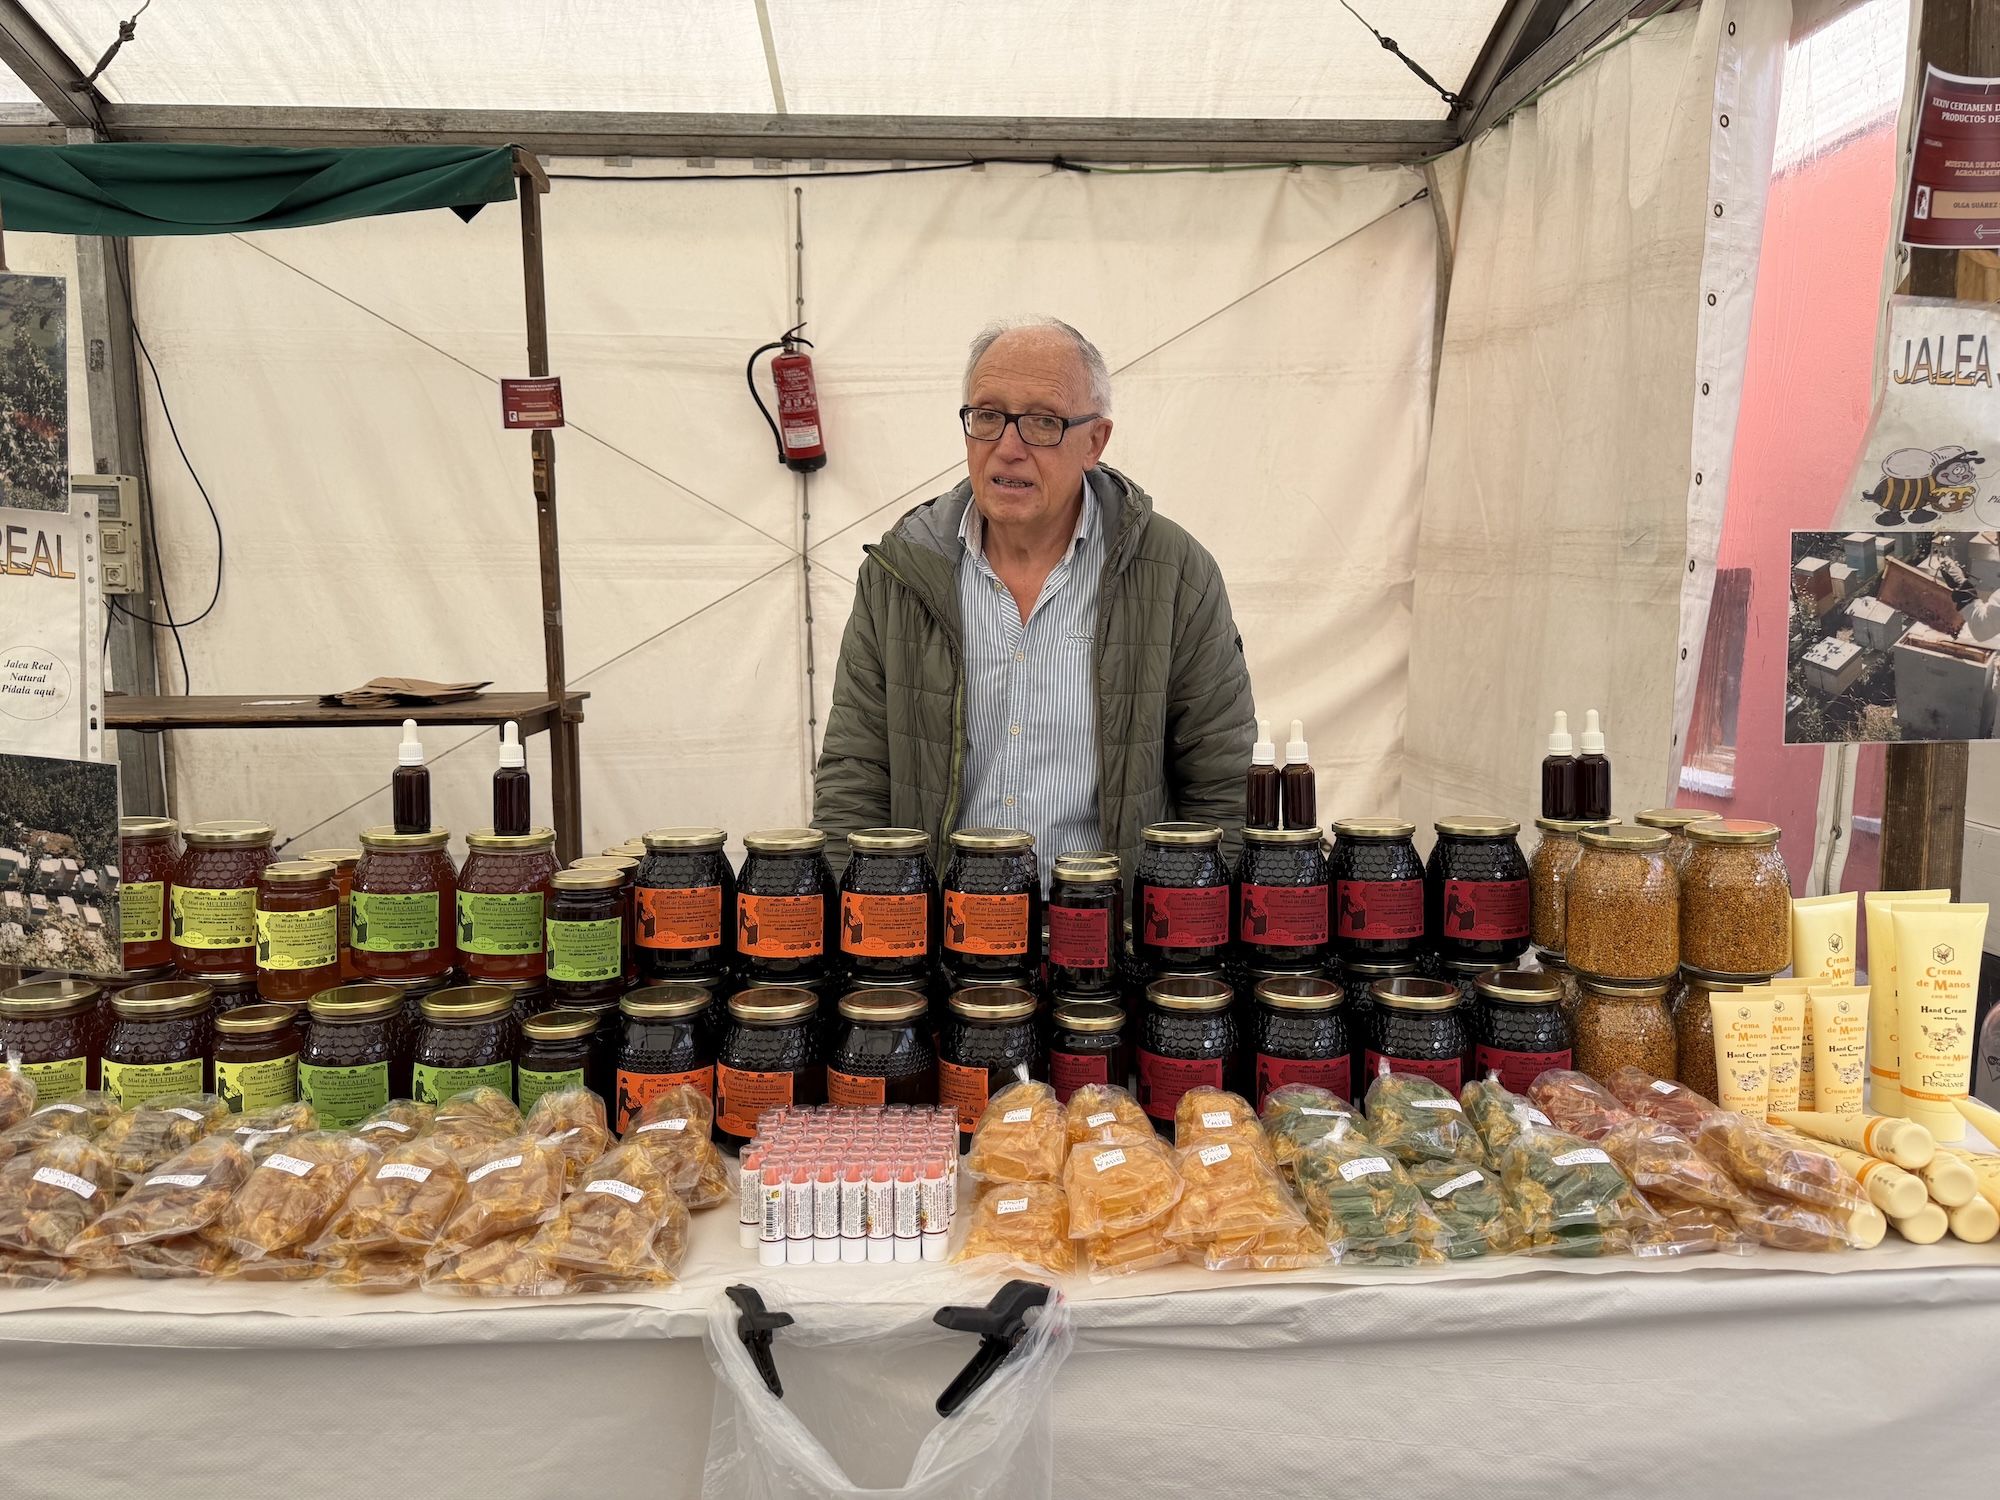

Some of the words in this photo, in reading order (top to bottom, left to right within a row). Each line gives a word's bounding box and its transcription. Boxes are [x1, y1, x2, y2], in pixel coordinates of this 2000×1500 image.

[1950, 101, 1990, 112] CERTAMEN
[1941, 112, 1986, 123] PRODUCTOS
[1945, 160, 1974, 168] MUESTRA
[1893, 334, 1992, 388] JALEA
[4, 659, 29, 671] Jalea
[32, 660, 53, 671] Real
[10, 672, 46, 683] Natural
[1, 684, 31, 696] Pídala
[33, 685, 55, 697] aquí
[1826, 956, 1850, 968] Crema
[1832, 968, 1855, 979] Manos
[1926, 967, 1962, 978] Crema
[1934, 979, 1971, 991] Manos
[1921, 1006, 1942, 1014] Hand
[1944, 1006, 1967, 1014] Cream
[1833, 1016, 1858, 1025] Crema
[1732, 1022, 1759, 1031] Crema
[1772, 1025, 1800, 1034] Manos
[1839, 1026, 1865, 1035] Manos
[1738, 1032, 1767, 1042] Manos
